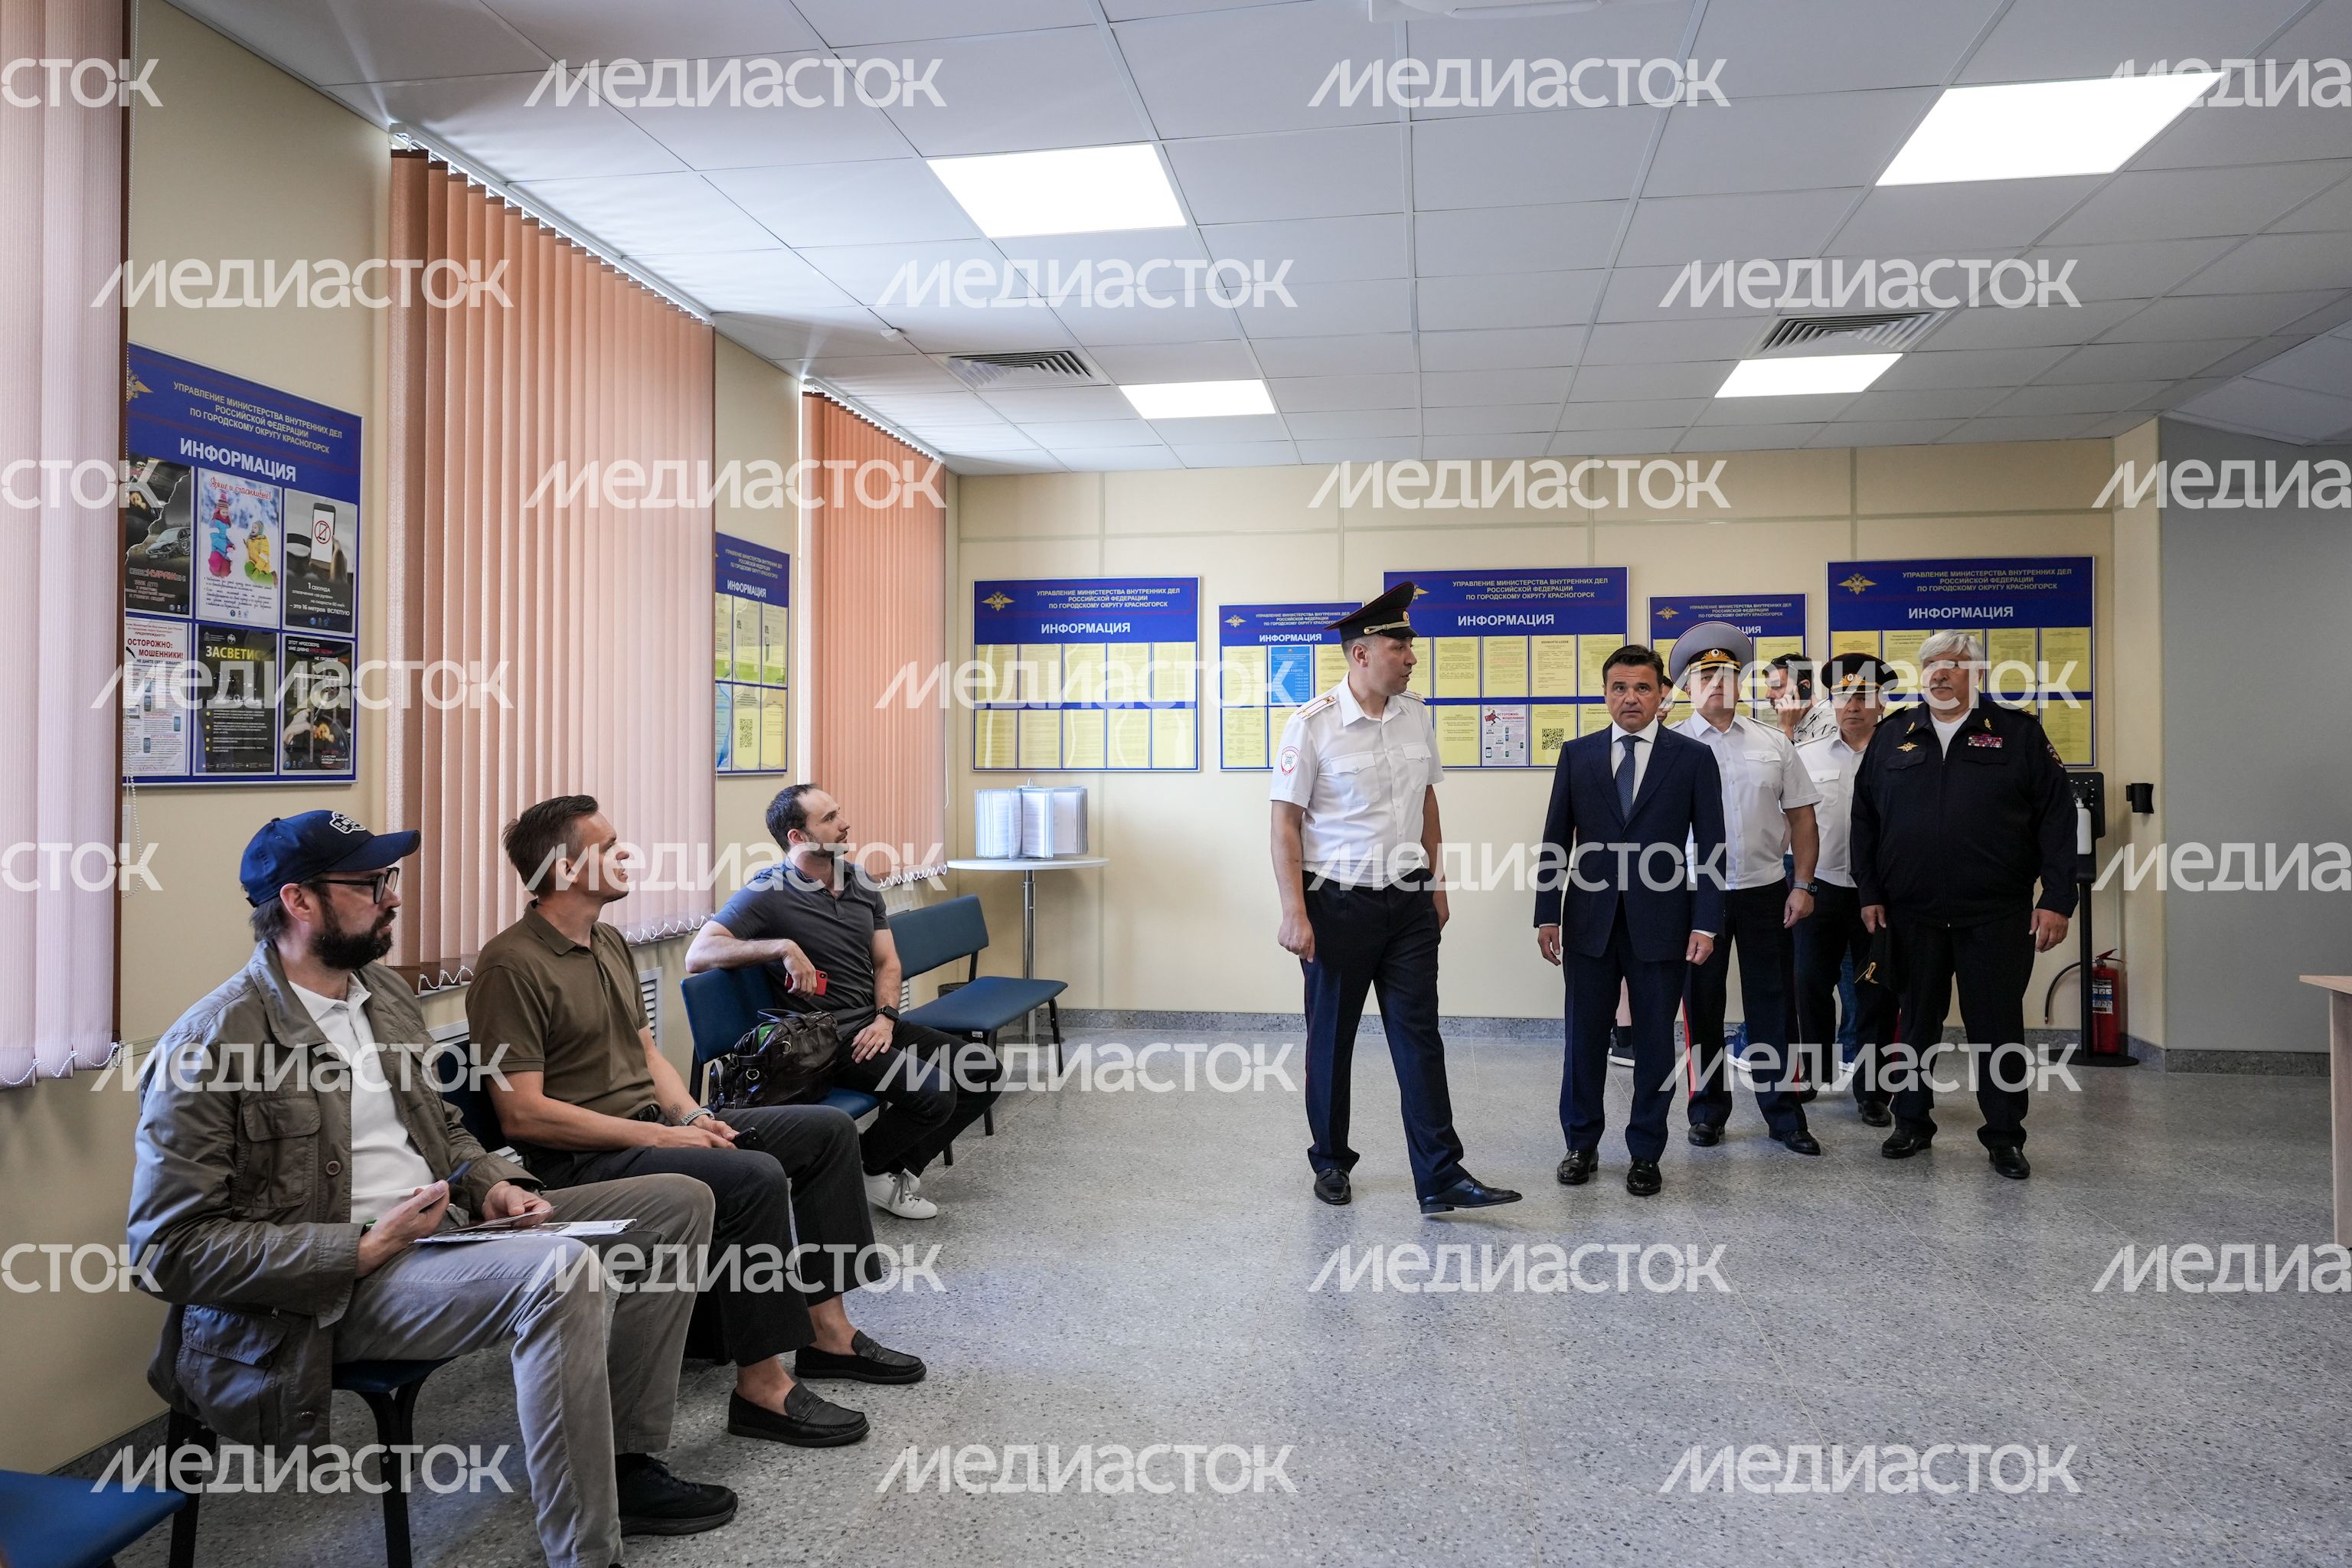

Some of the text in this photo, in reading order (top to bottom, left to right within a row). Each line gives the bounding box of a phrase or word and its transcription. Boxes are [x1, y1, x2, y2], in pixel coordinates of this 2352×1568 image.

[173, 381, 342, 439] УПРАВЛЕНИЕ МИНИСТЕРСТВА ВНУТРЕННИХ ДЕЛ
[215, 404, 309, 439] РОССИЙСКОЙ ФЕДЕРАЦИИ
[190, 407, 330, 454] ПО ГОРОДСКОМУ ОКРУГУ КРАСНОГОРСК
[180, 437, 296, 482] ИНФОРМАЦИЯ
[1940, 577, 1988, 585] РОССИЙСКОЙ
[727, 580, 766, 598] ИНФОРМАЦИЯ
[1908, 606, 2014, 619] ИНФОРМАЦИЯ
[1458, 614, 1554, 626] ИНФОРМАЦИЯ
[1041, 622, 1131, 635] ИНФОРМАЦИЯ
[128, 639, 172, 648] ОСТОРОЖНО:
[1259, 634, 1321, 642] ИНФОРМАЦИЯ
[139, 649, 183, 658] МОШЕННИКИ!
